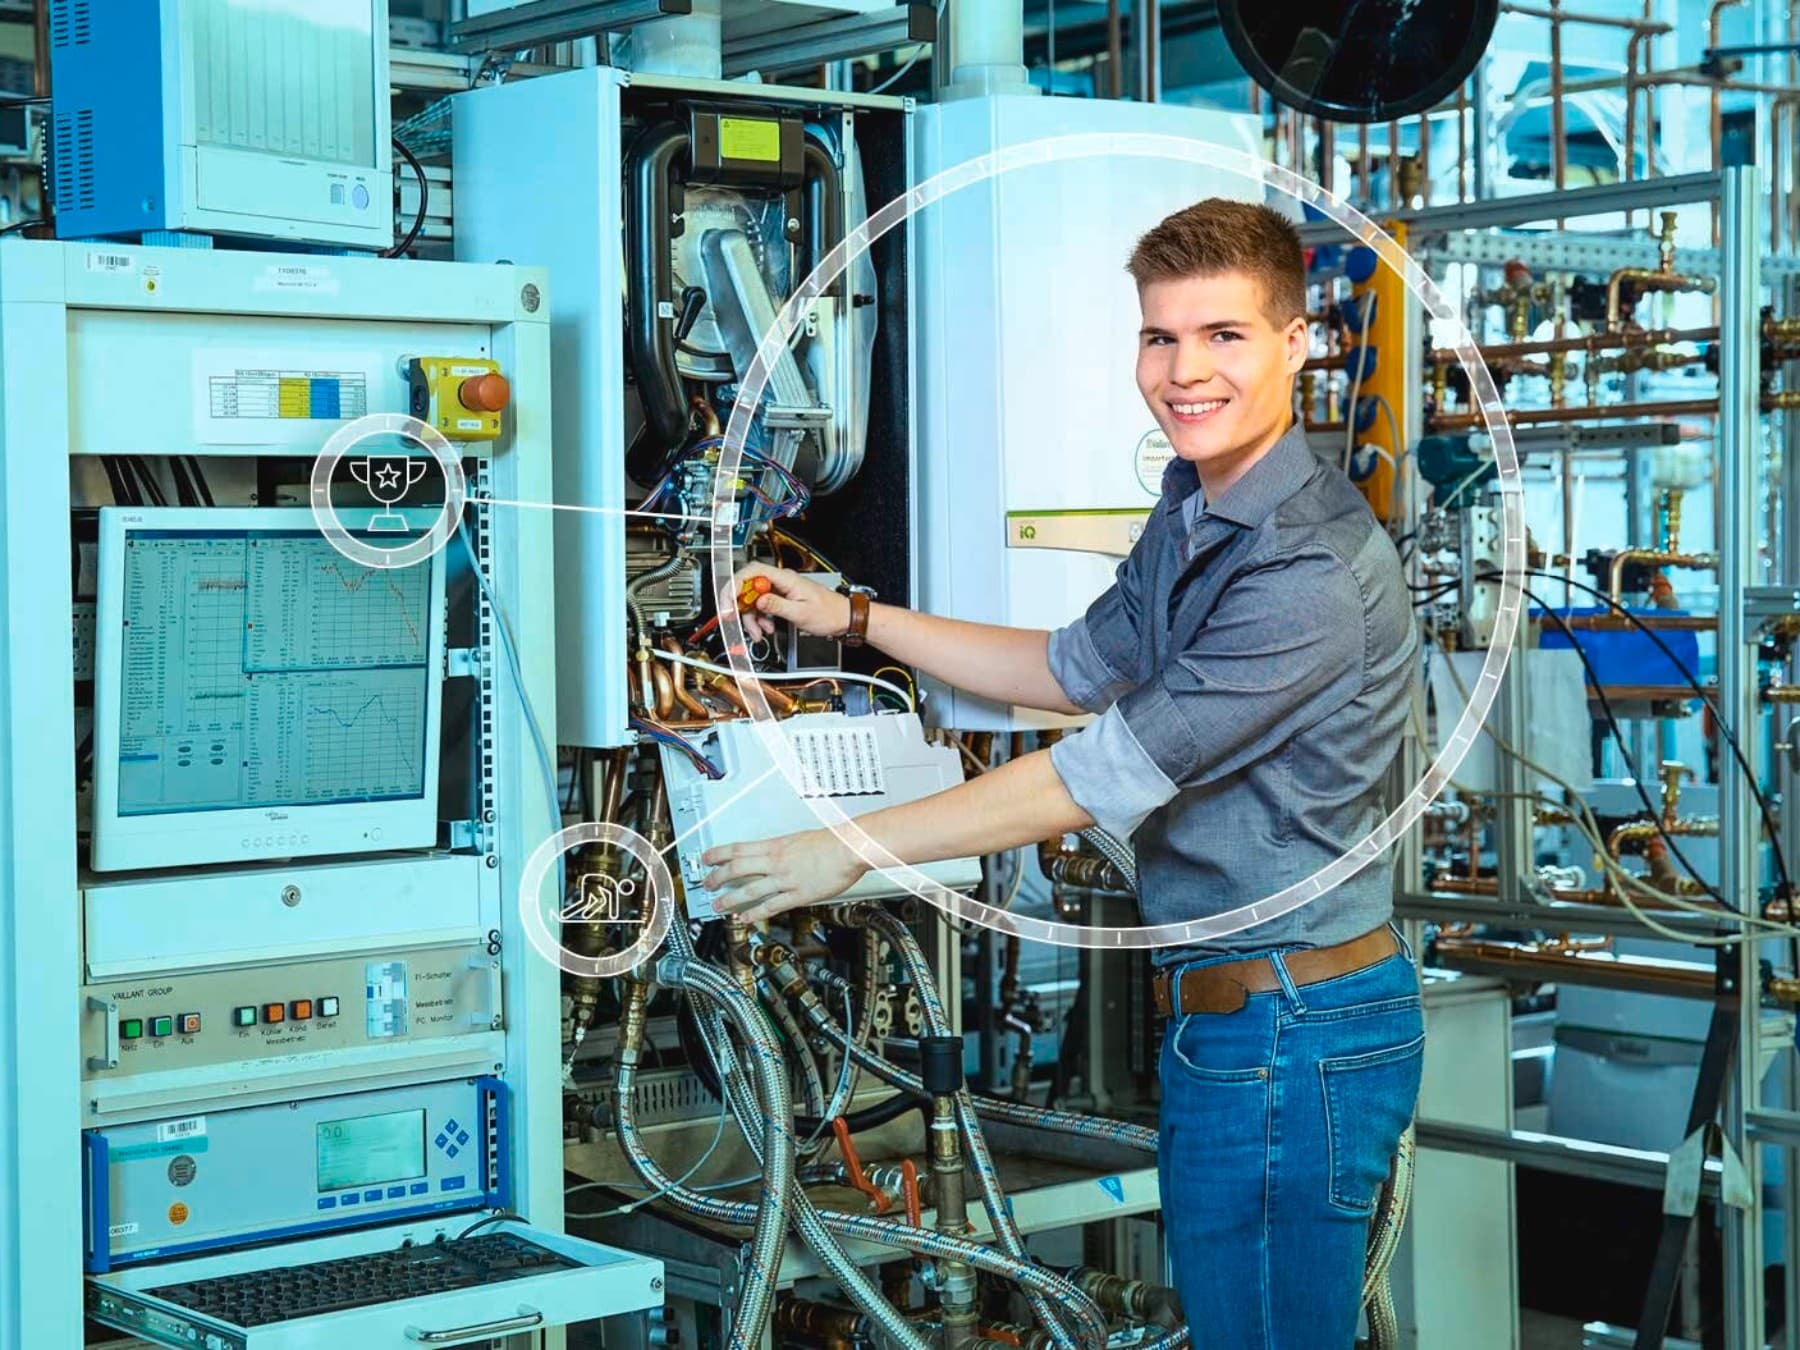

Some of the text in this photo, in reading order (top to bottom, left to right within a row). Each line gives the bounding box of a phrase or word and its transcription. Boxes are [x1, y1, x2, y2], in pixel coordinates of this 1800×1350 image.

[1019, 525, 1036, 540] iQ
[112, 986, 173, 1000] VAILLANT GROUP
